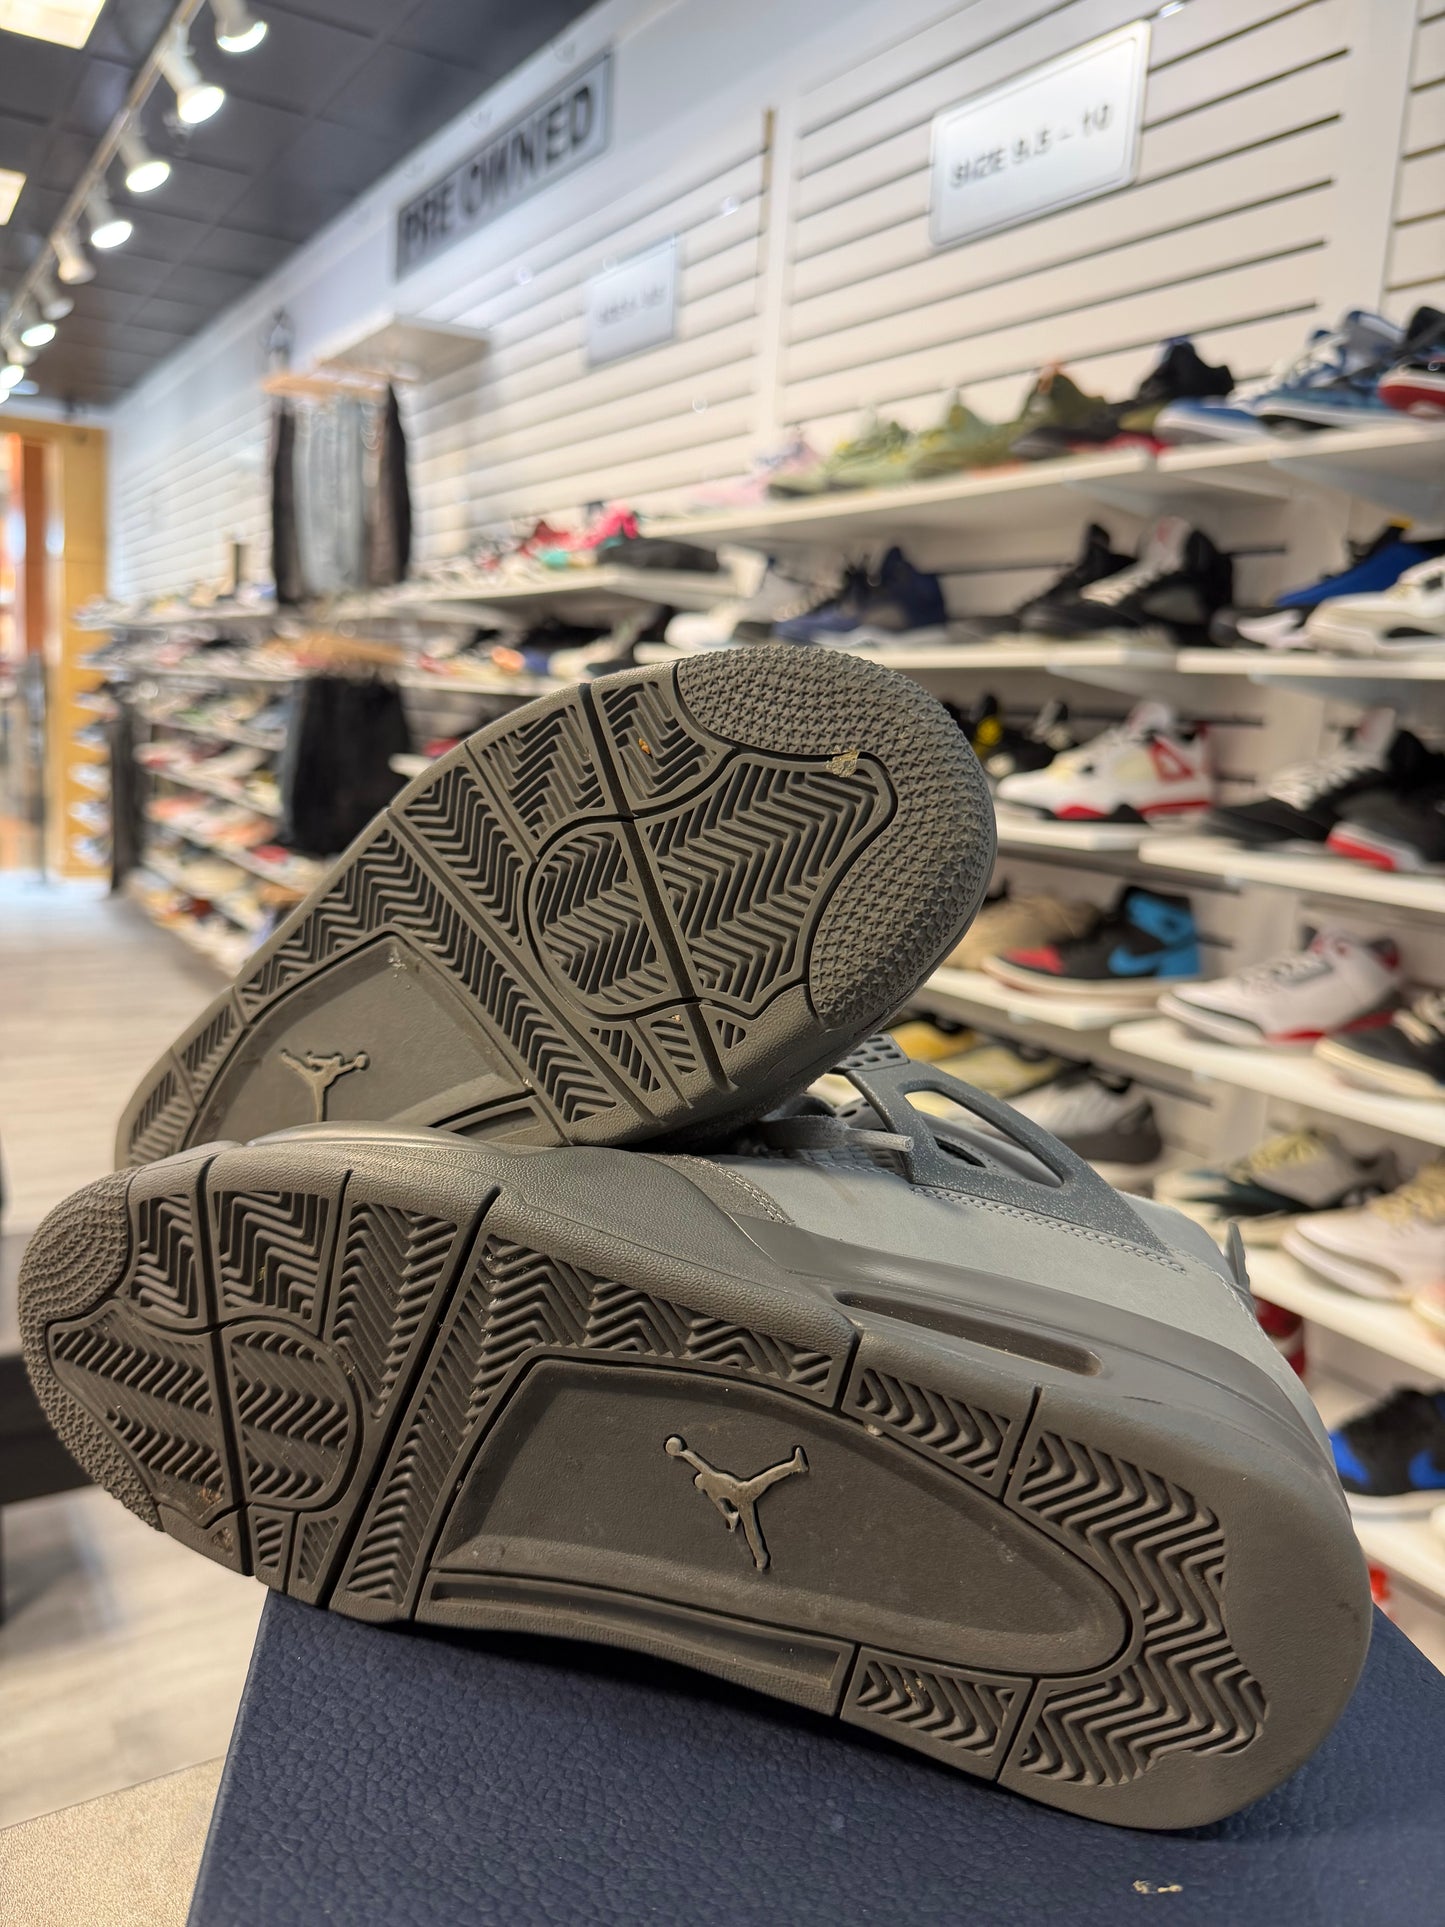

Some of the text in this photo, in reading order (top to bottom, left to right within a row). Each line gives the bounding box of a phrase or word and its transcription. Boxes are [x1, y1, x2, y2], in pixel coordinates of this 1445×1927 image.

[403, 84, 593, 245] PRE OWNED
[950, 149, 1005, 189] SIZE
[1082, 103, 1113, 136] 10
